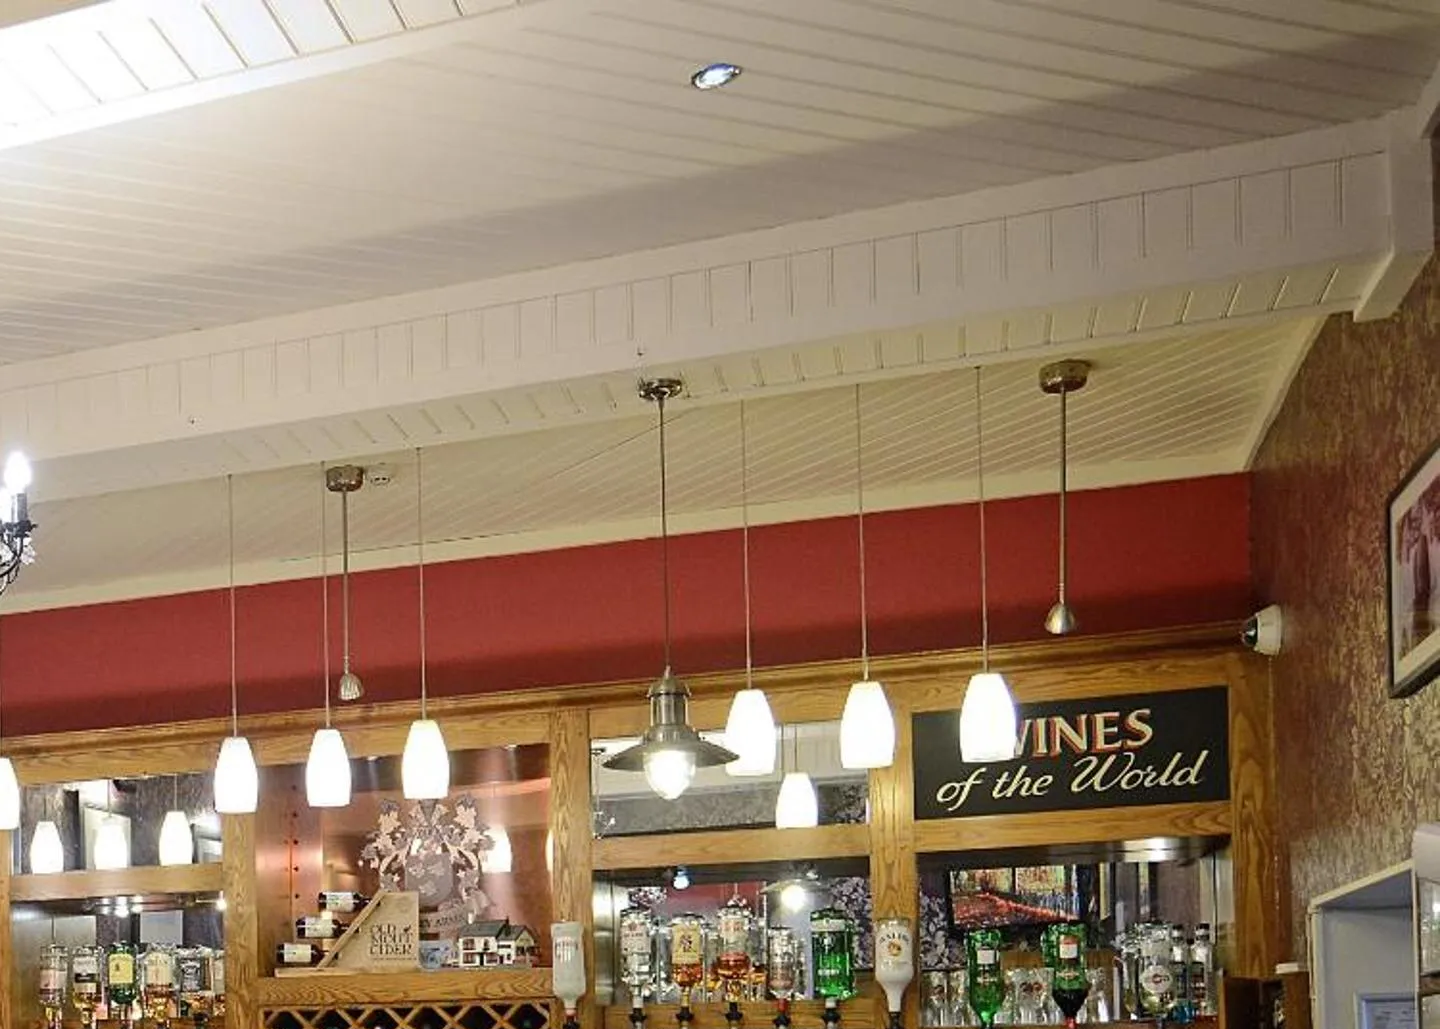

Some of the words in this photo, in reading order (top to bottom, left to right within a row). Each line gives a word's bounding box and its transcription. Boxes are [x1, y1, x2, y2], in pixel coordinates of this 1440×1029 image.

[936, 767, 987, 811] of
[992, 765, 1053, 799] the
[1071, 750, 1209, 793] World
[370, 943, 412, 955] CIDER
